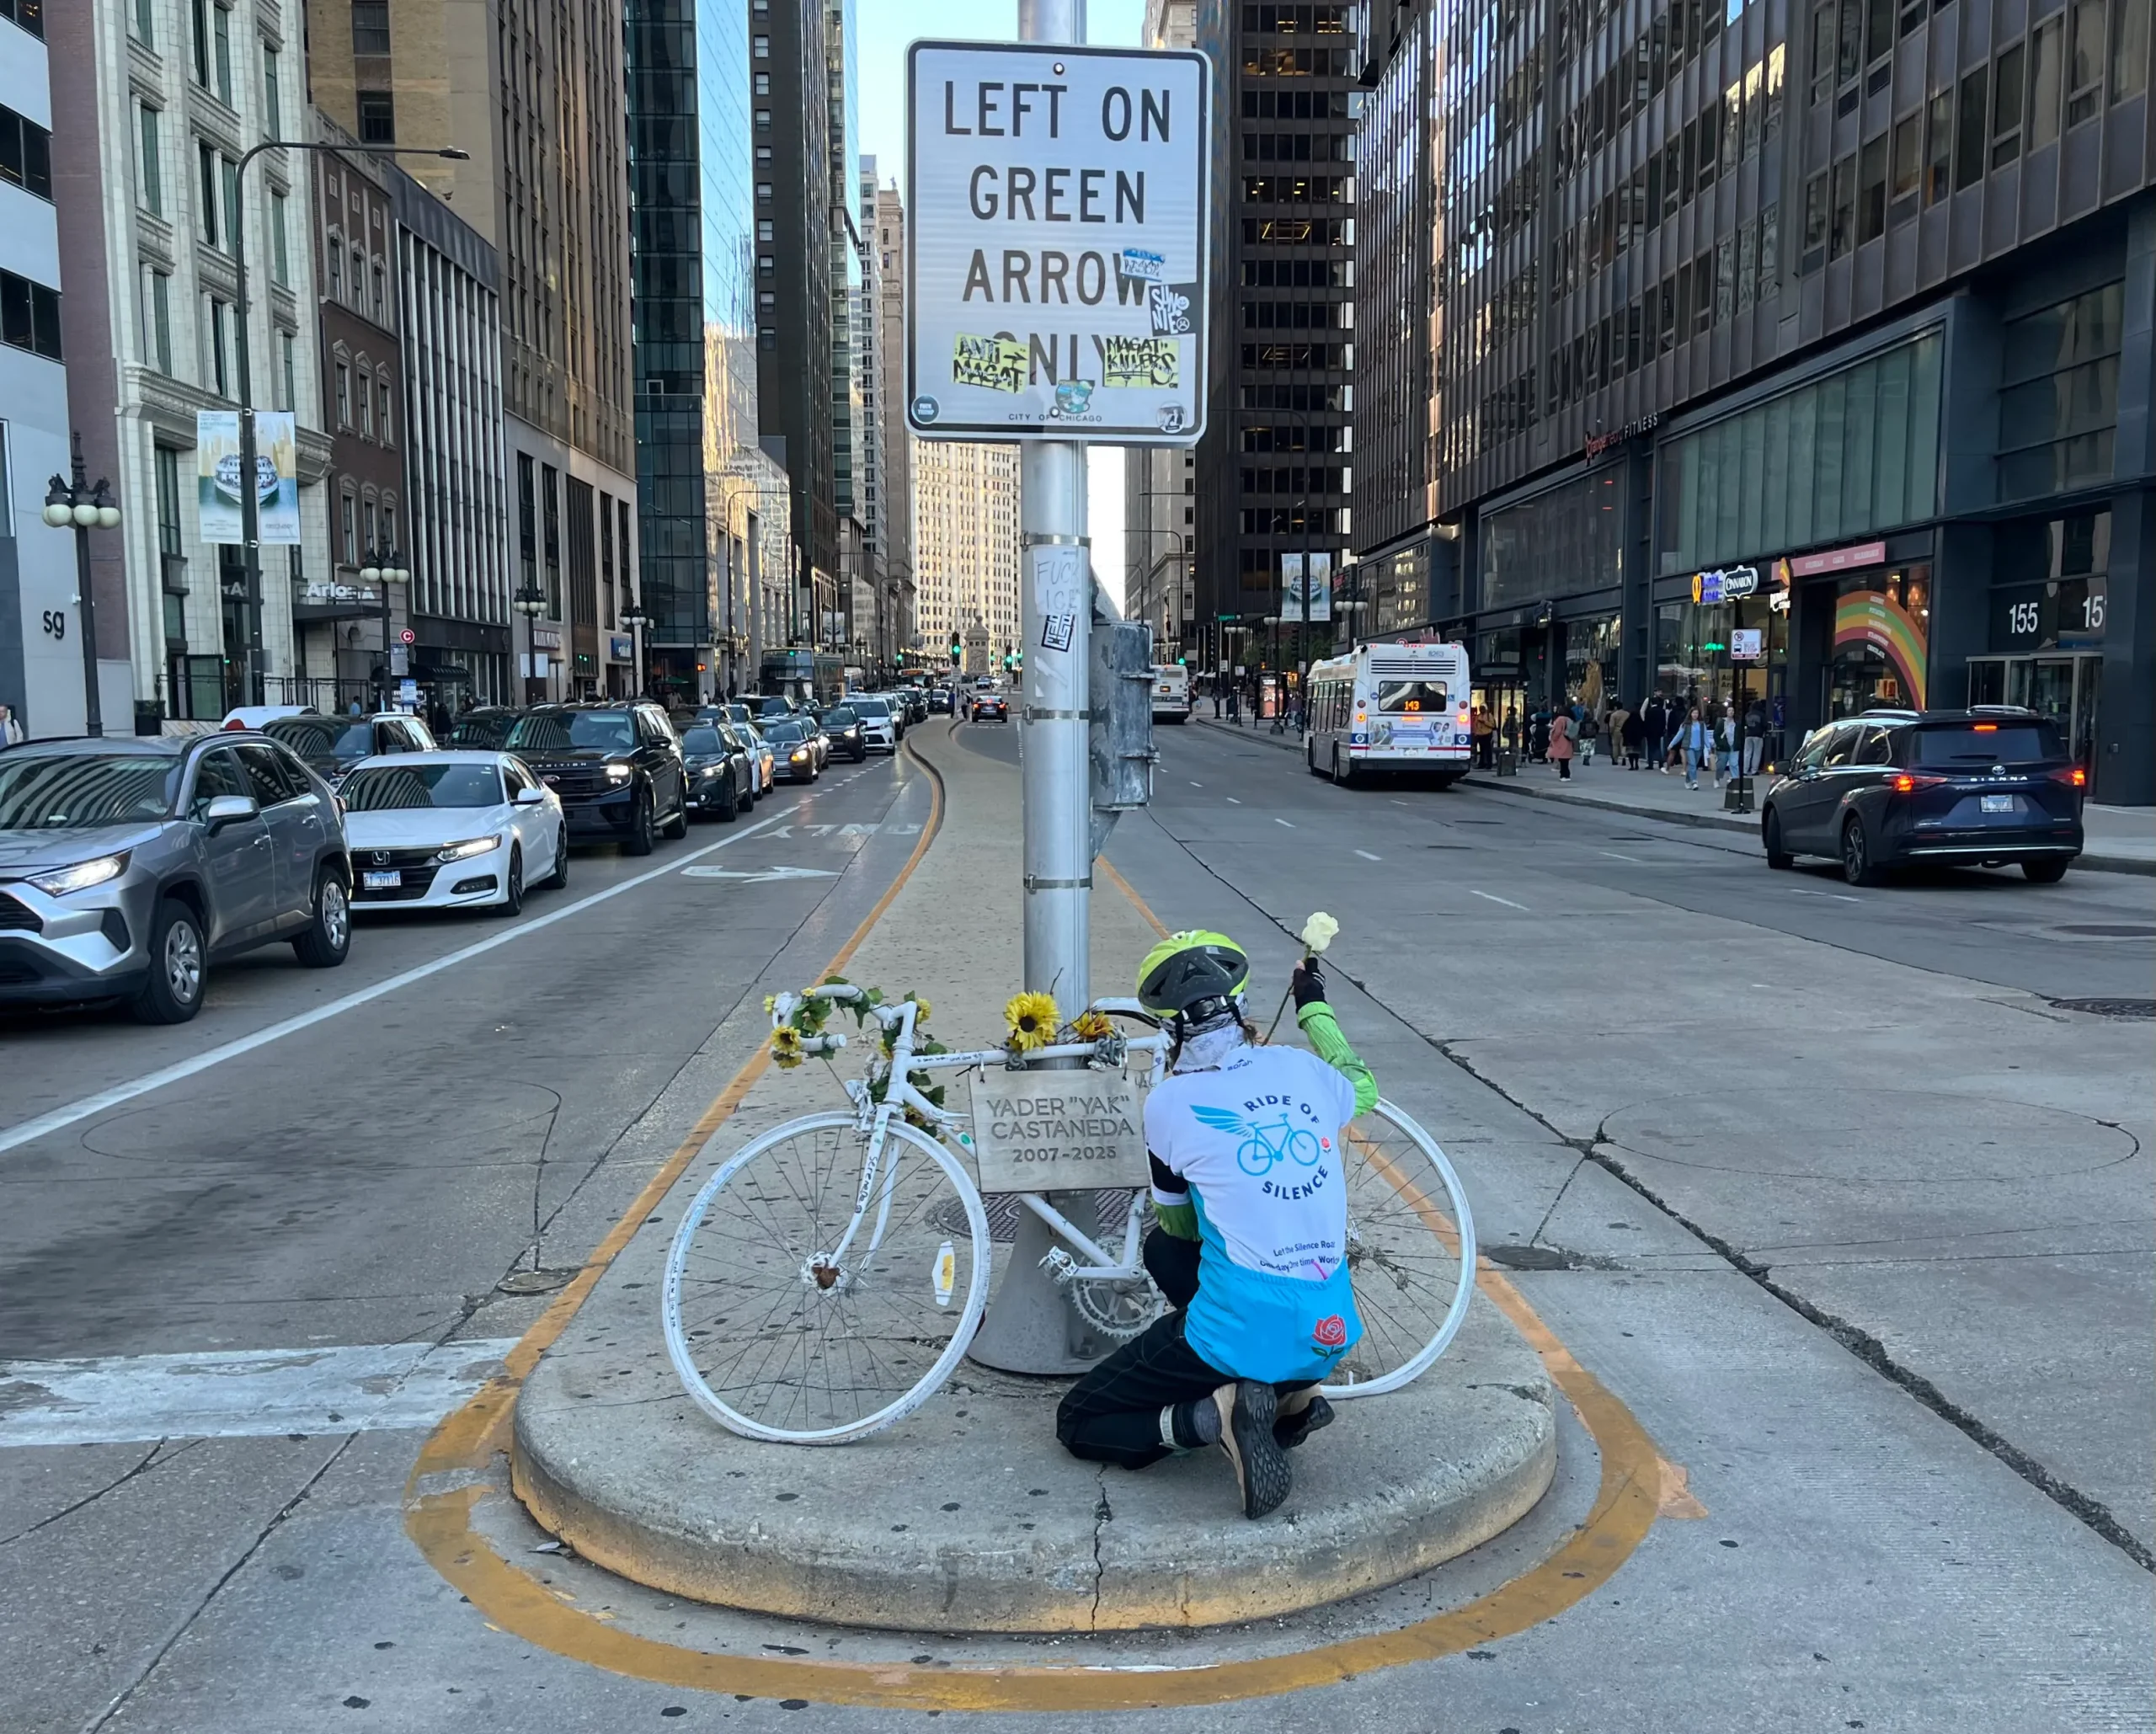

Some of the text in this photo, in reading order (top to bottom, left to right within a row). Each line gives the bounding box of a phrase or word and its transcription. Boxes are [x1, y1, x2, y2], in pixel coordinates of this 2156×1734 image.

[945, 81, 1170, 142] LEFT ON
[969, 164, 1145, 224] GREEN
[963, 249, 1146, 307] ARROW
[1625, 412, 1658, 440] FITNESS
[1036, 561, 1080, 585] FUCK
[1046, 589, 1081, 610] ICE
[43, 610, 65, 640] sg
[2009, 602, 2038, 633] 155
[1404, 700, 1420, 712] 143
[986, 1098, 1065, 1118] YADER
[1243, 1095, 1321, 1124] RIDE OF
[990, 1118, 1135, 1140] CASTANEDA
[1012, 1146, 1118, 1164] 2007-2025
[1262, 1165, 1329, 1201] SILENCE
[1273, 1248, 1285, 1256] Let
[1285, 1246, 1294, 1255] the
[1294, 1241, 1320, 1252] Silence
